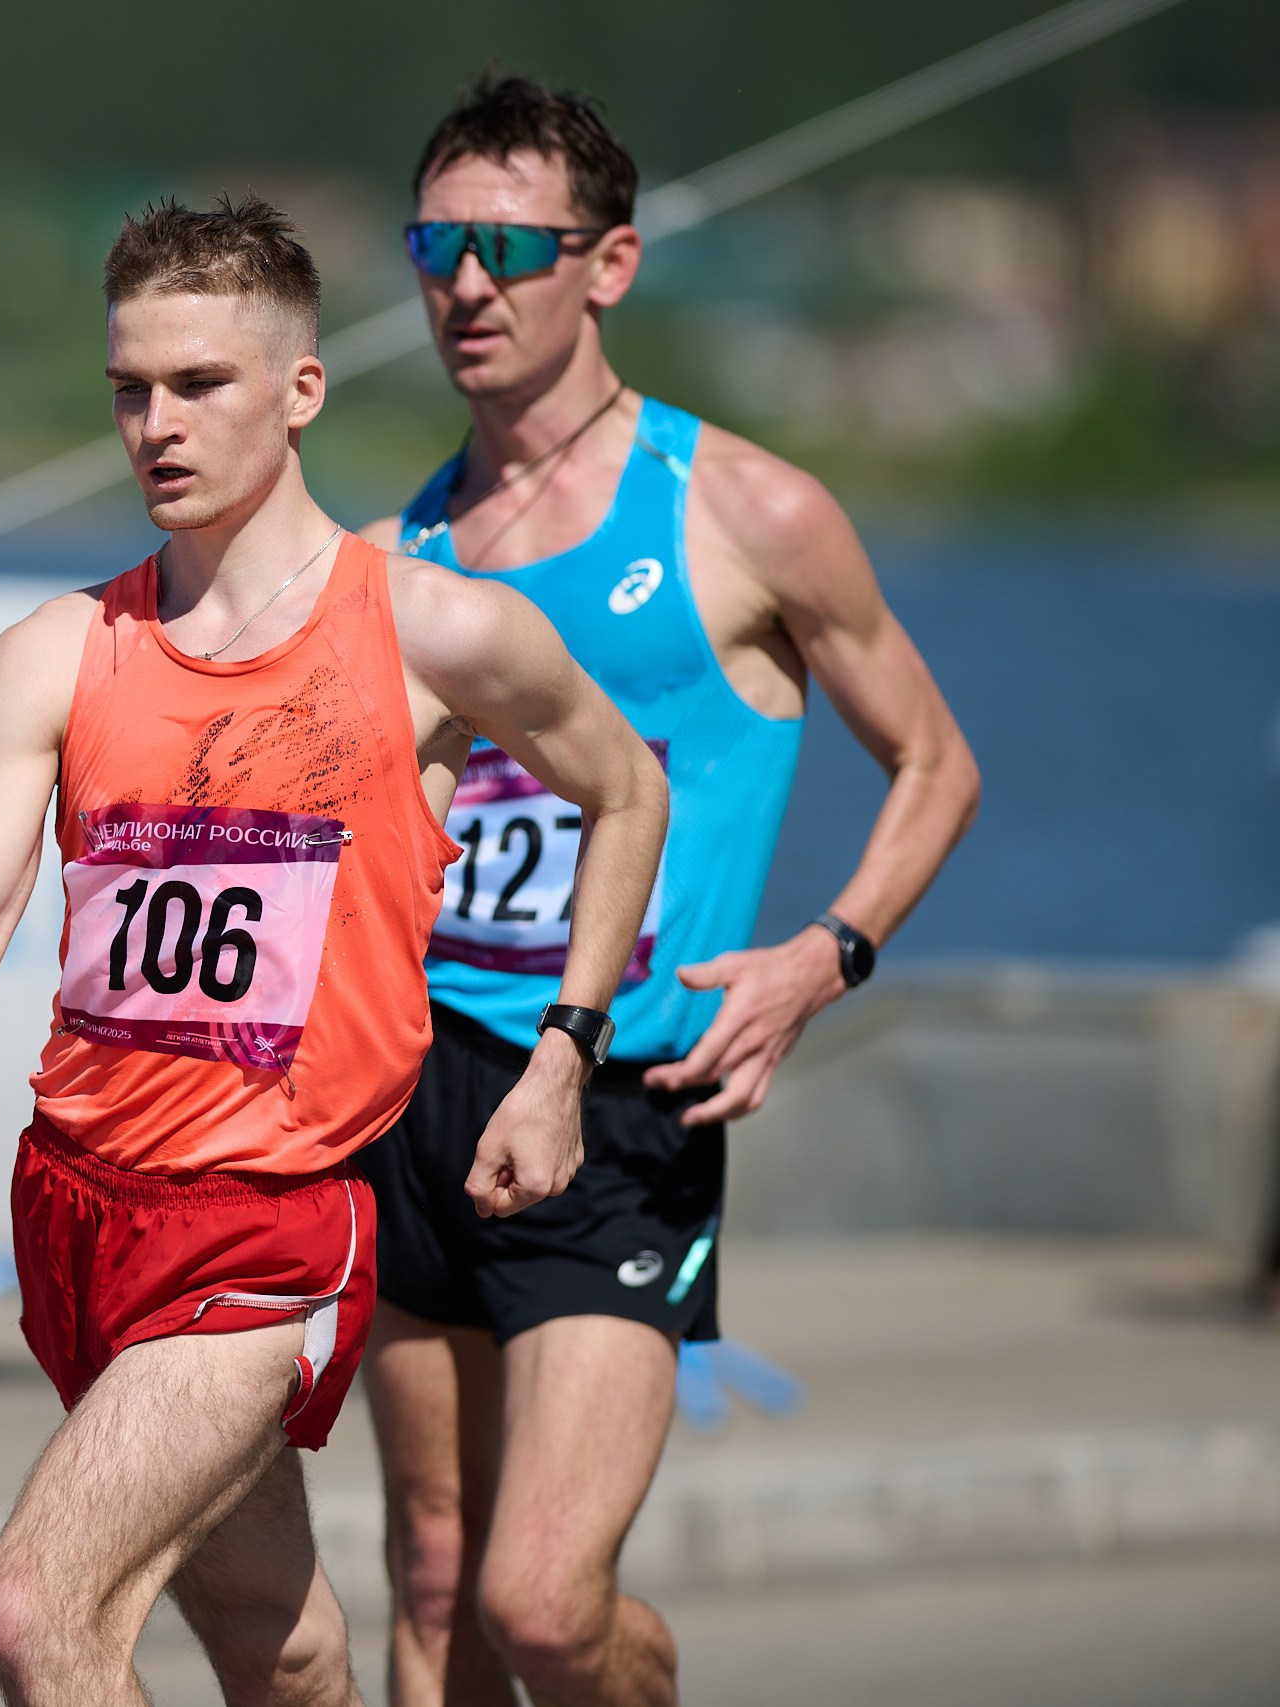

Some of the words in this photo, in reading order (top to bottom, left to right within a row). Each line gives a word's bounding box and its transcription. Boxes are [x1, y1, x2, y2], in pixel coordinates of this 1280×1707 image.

[91, 821, 205, 841] ЧЕМПИОНАТ
[208, 825, 308, 849] РОССИИ
[108, 878, 263, 1003] 106
[106, 1027, 132, 1041] 2025
